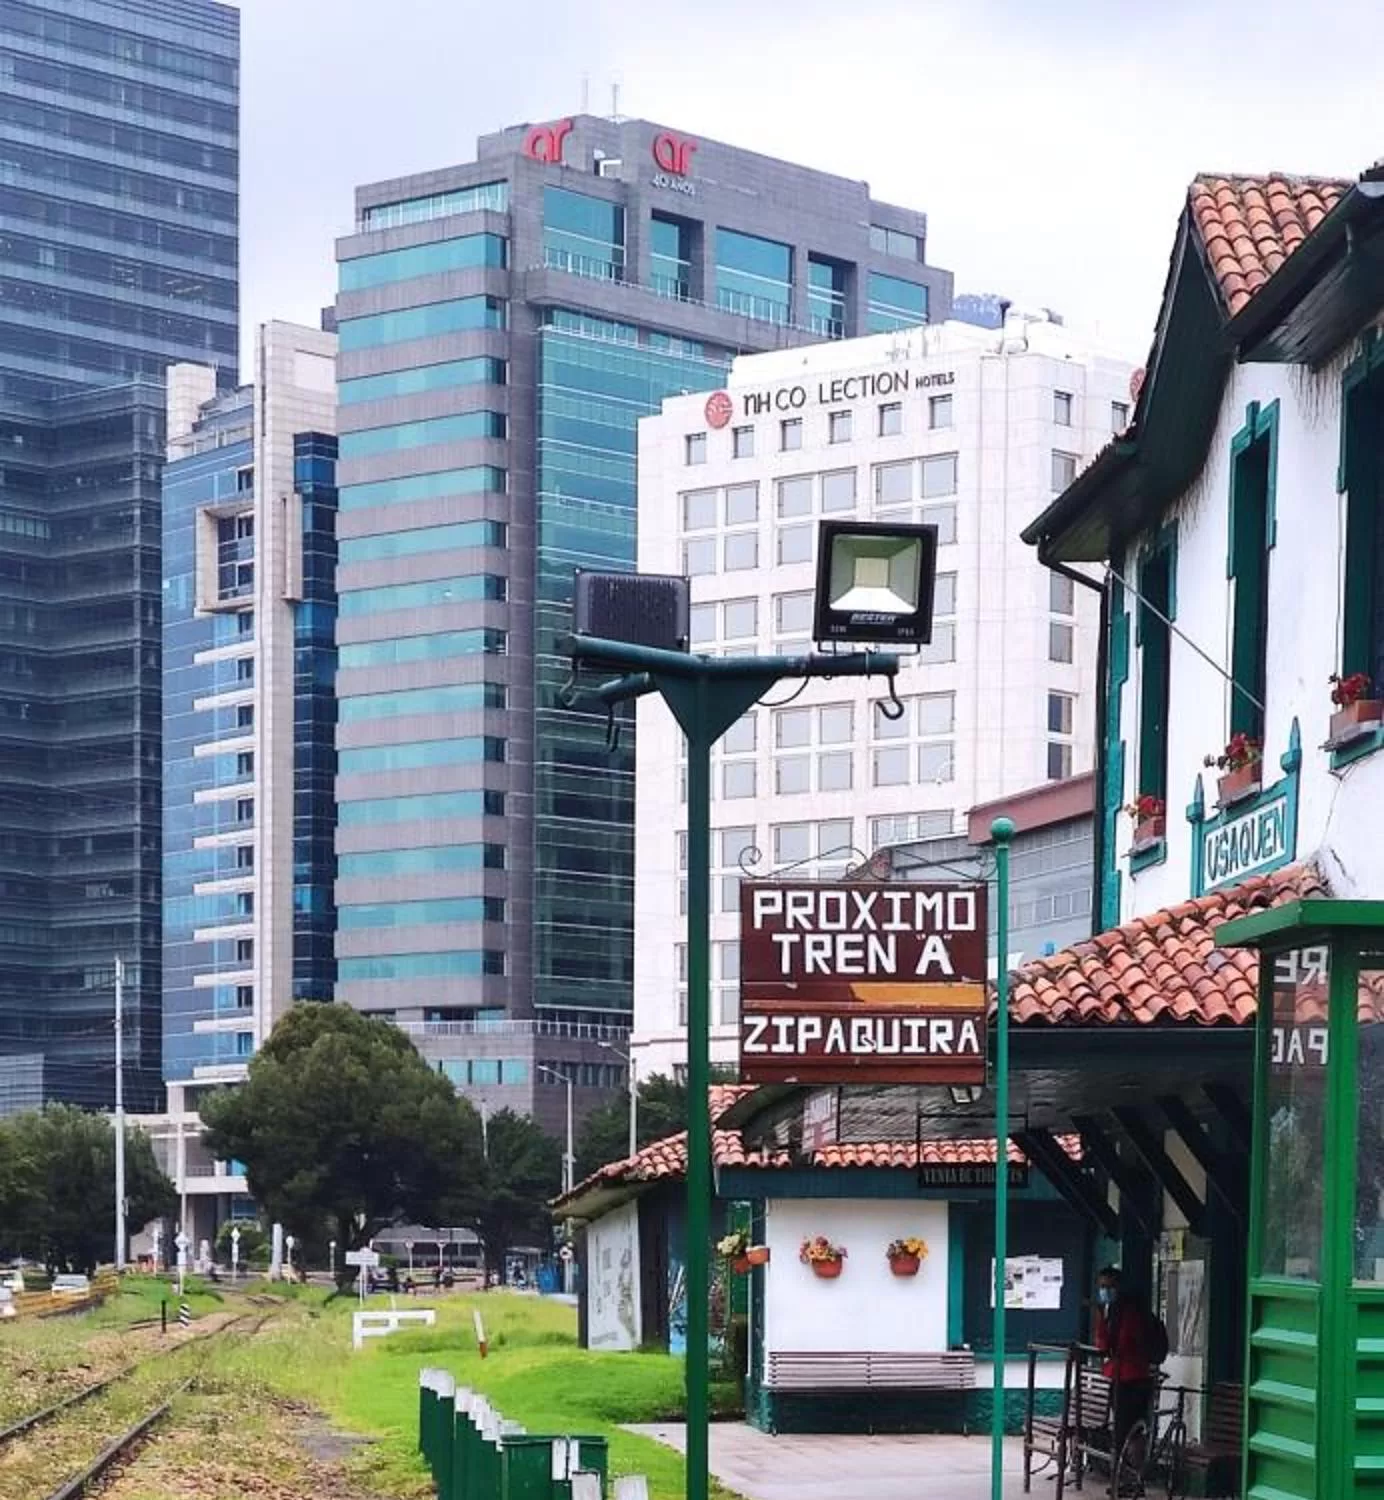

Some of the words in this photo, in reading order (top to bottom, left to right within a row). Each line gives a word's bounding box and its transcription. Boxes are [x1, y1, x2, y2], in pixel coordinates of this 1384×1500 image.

[915, 371, 955, 389] HOTELS
[753, 890, 976, 931] PROXIMO
[772, 932, 897, 975] TREN
